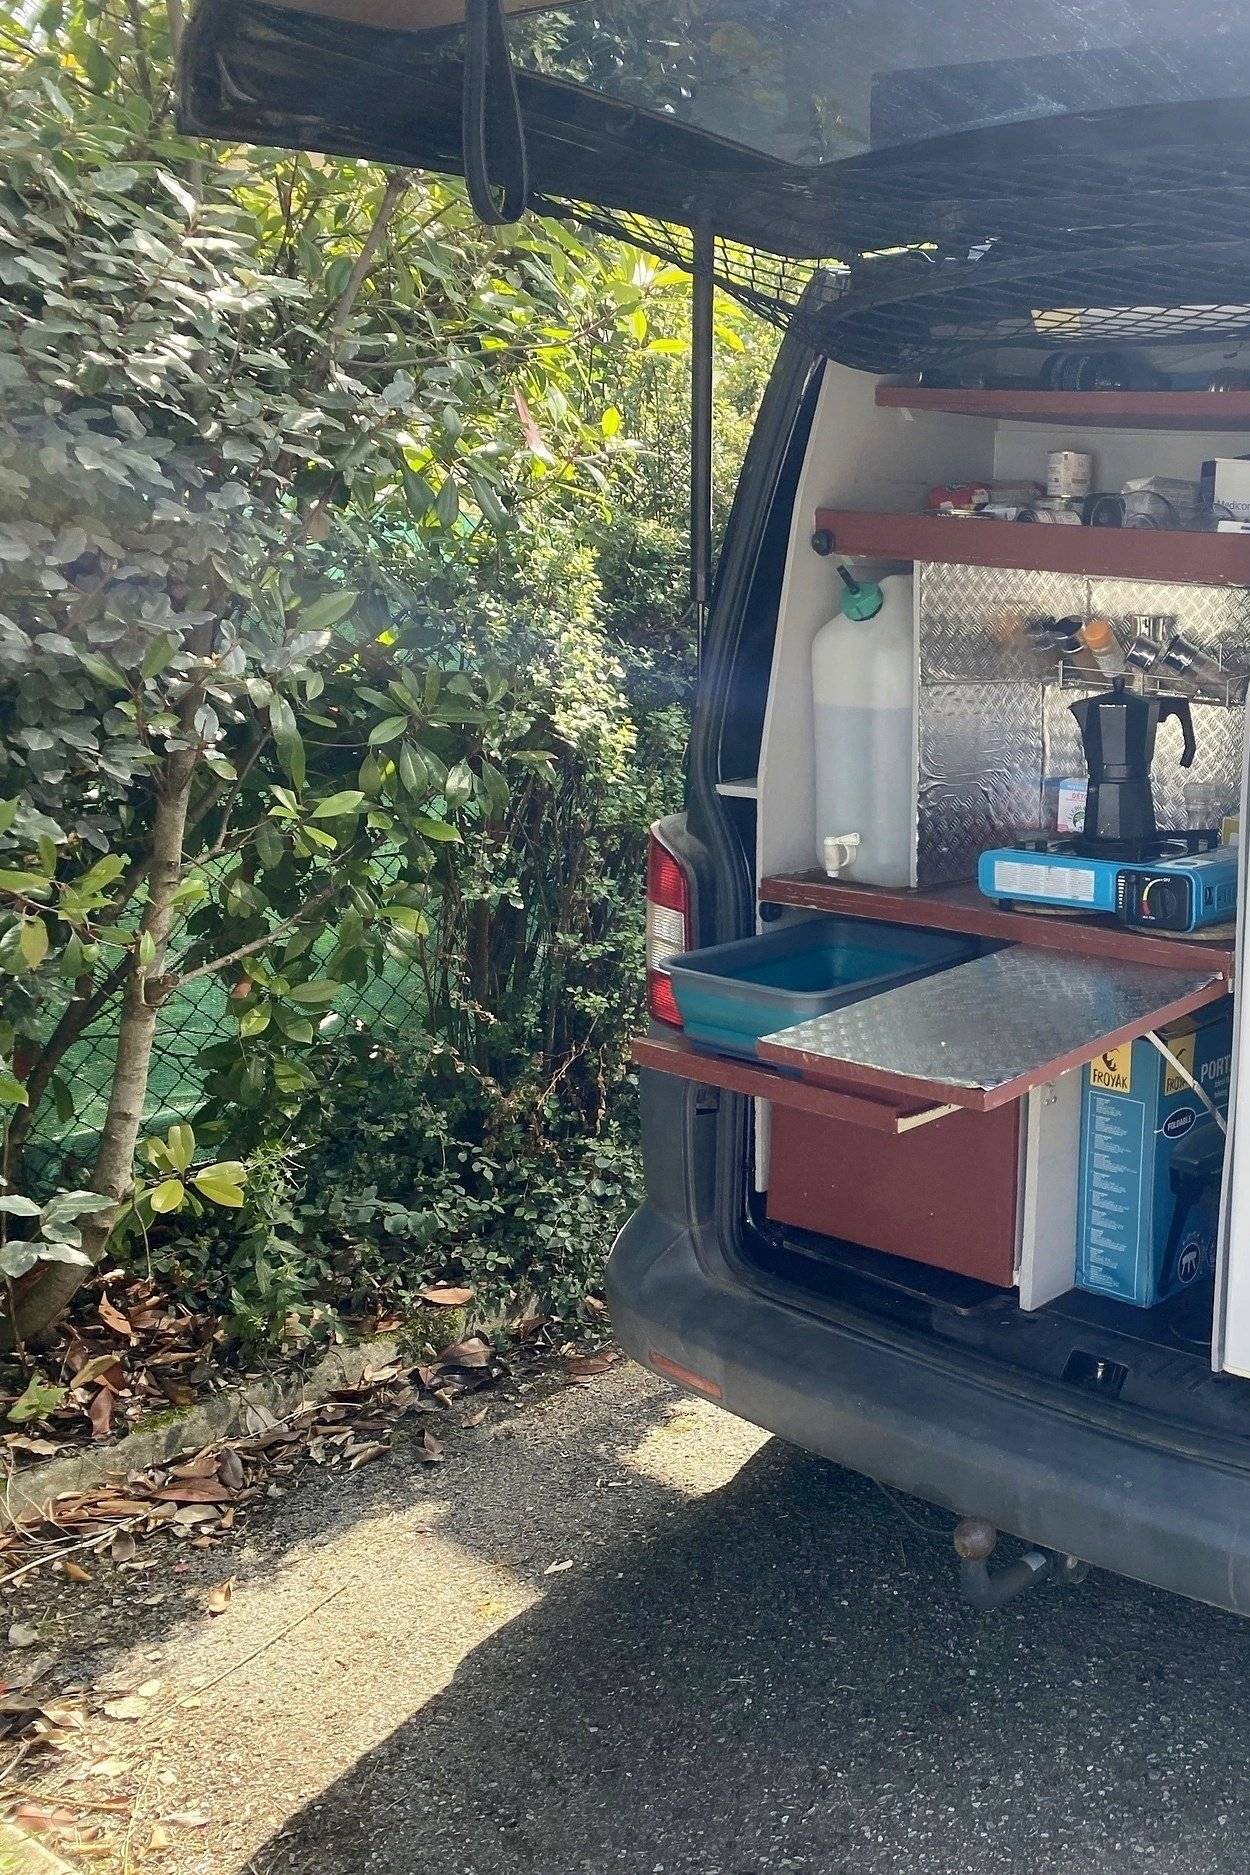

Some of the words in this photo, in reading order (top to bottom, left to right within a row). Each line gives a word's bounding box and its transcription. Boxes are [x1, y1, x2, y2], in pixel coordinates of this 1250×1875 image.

[1201, 1054, 1231, 1082] PORT
[1093, 1069, 1128, 1090] FROYAK
[1167, 1114, 1192, 1131] FOLDABLE
